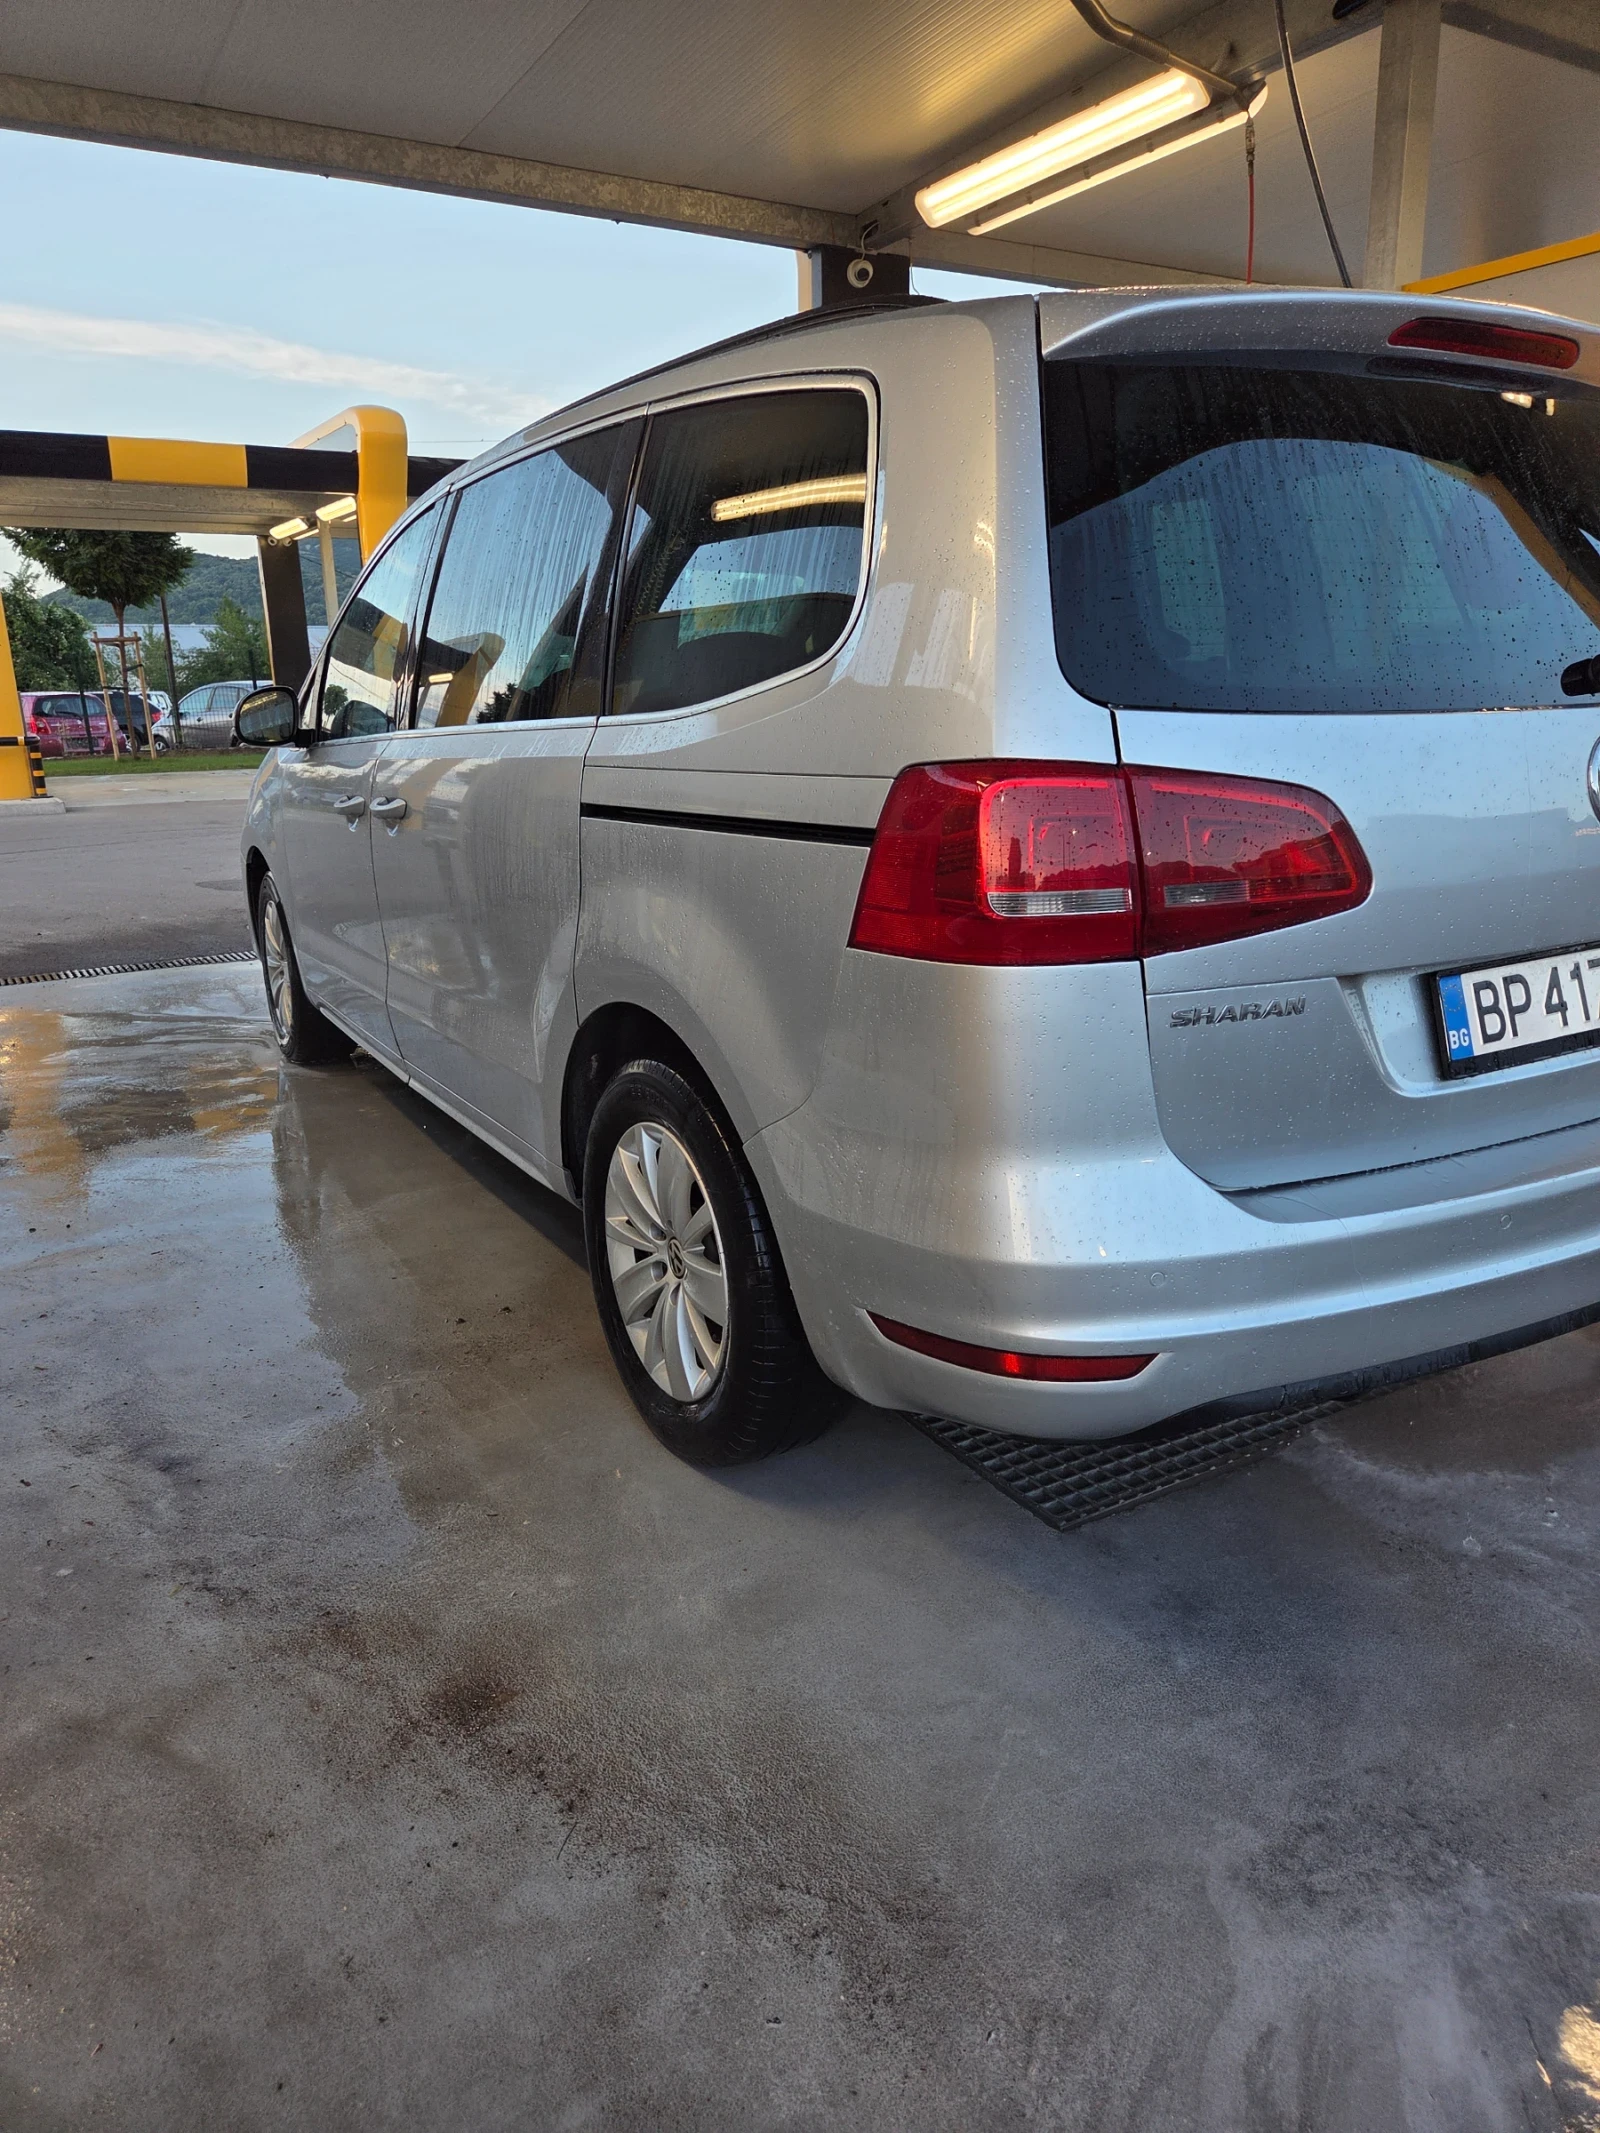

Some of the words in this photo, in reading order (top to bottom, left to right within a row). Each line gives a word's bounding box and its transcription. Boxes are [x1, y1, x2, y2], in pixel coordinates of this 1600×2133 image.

[1169, 996, 1307, 1029] SHARAN
[1473, 973, 1532, 1045] BP
[1449, 1028, 1470, 1049] BG
